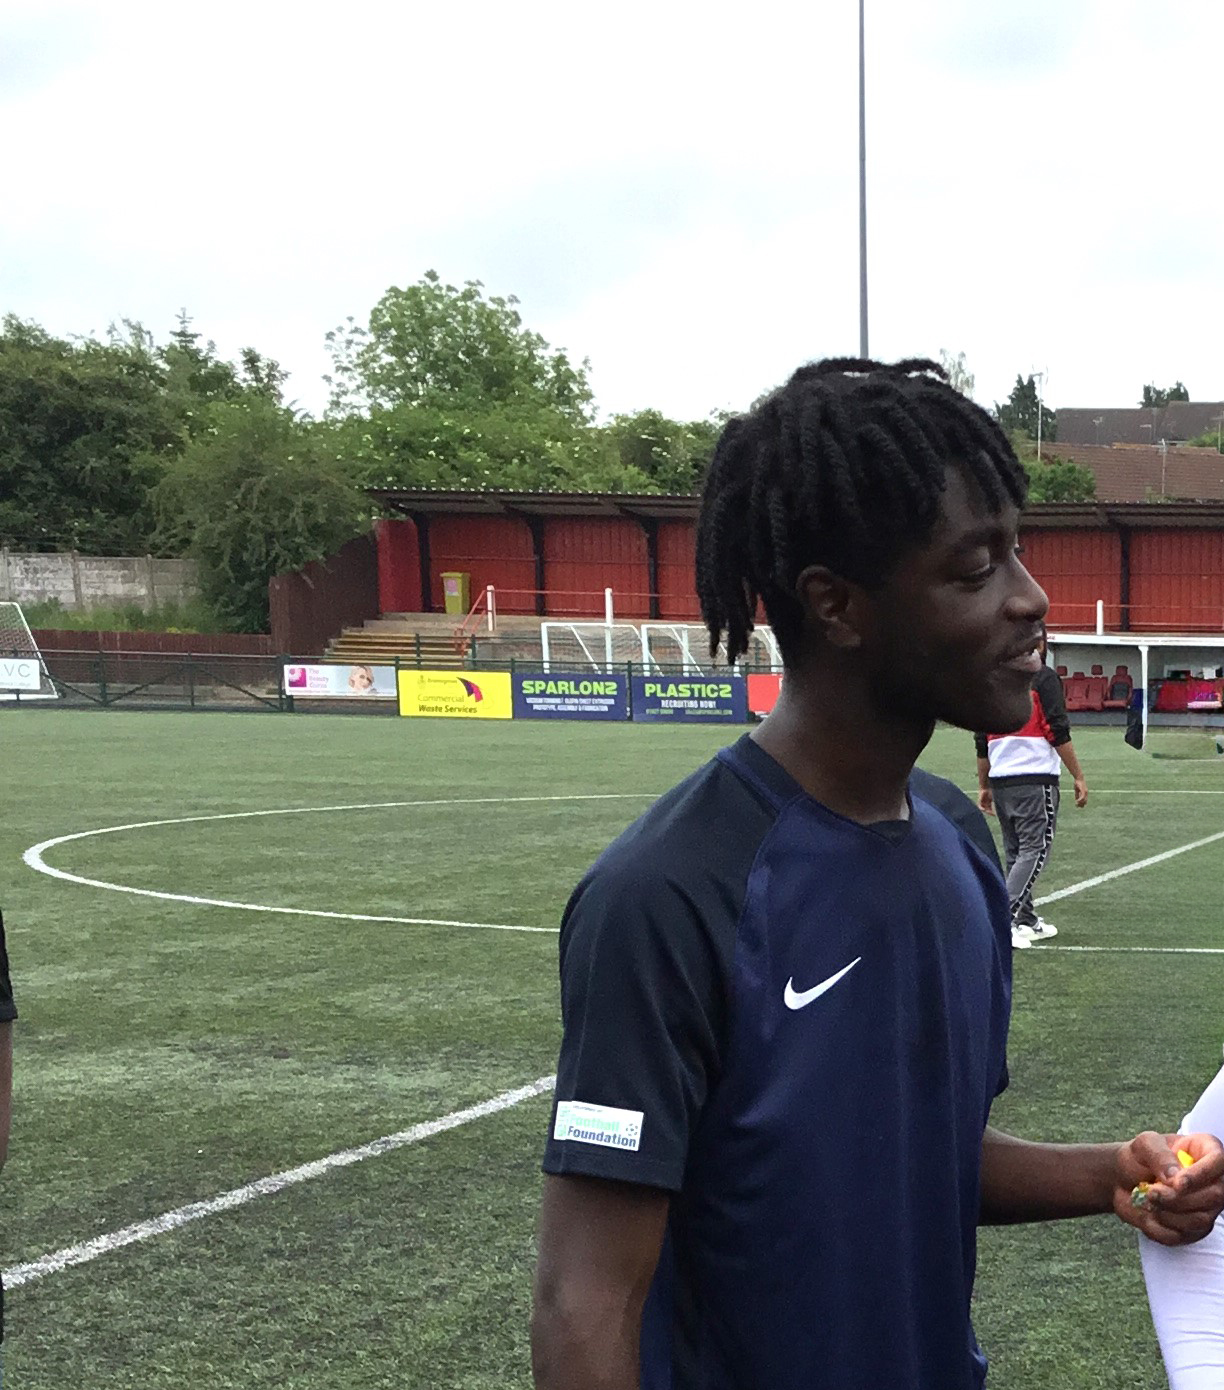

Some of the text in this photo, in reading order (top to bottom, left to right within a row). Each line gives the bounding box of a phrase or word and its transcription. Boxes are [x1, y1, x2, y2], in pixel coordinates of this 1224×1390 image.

[418, 694, 465, 703] Commercial
[419, 704, 478, 714] Waste Services
[567, 1125, 637, 1148] Foundation
